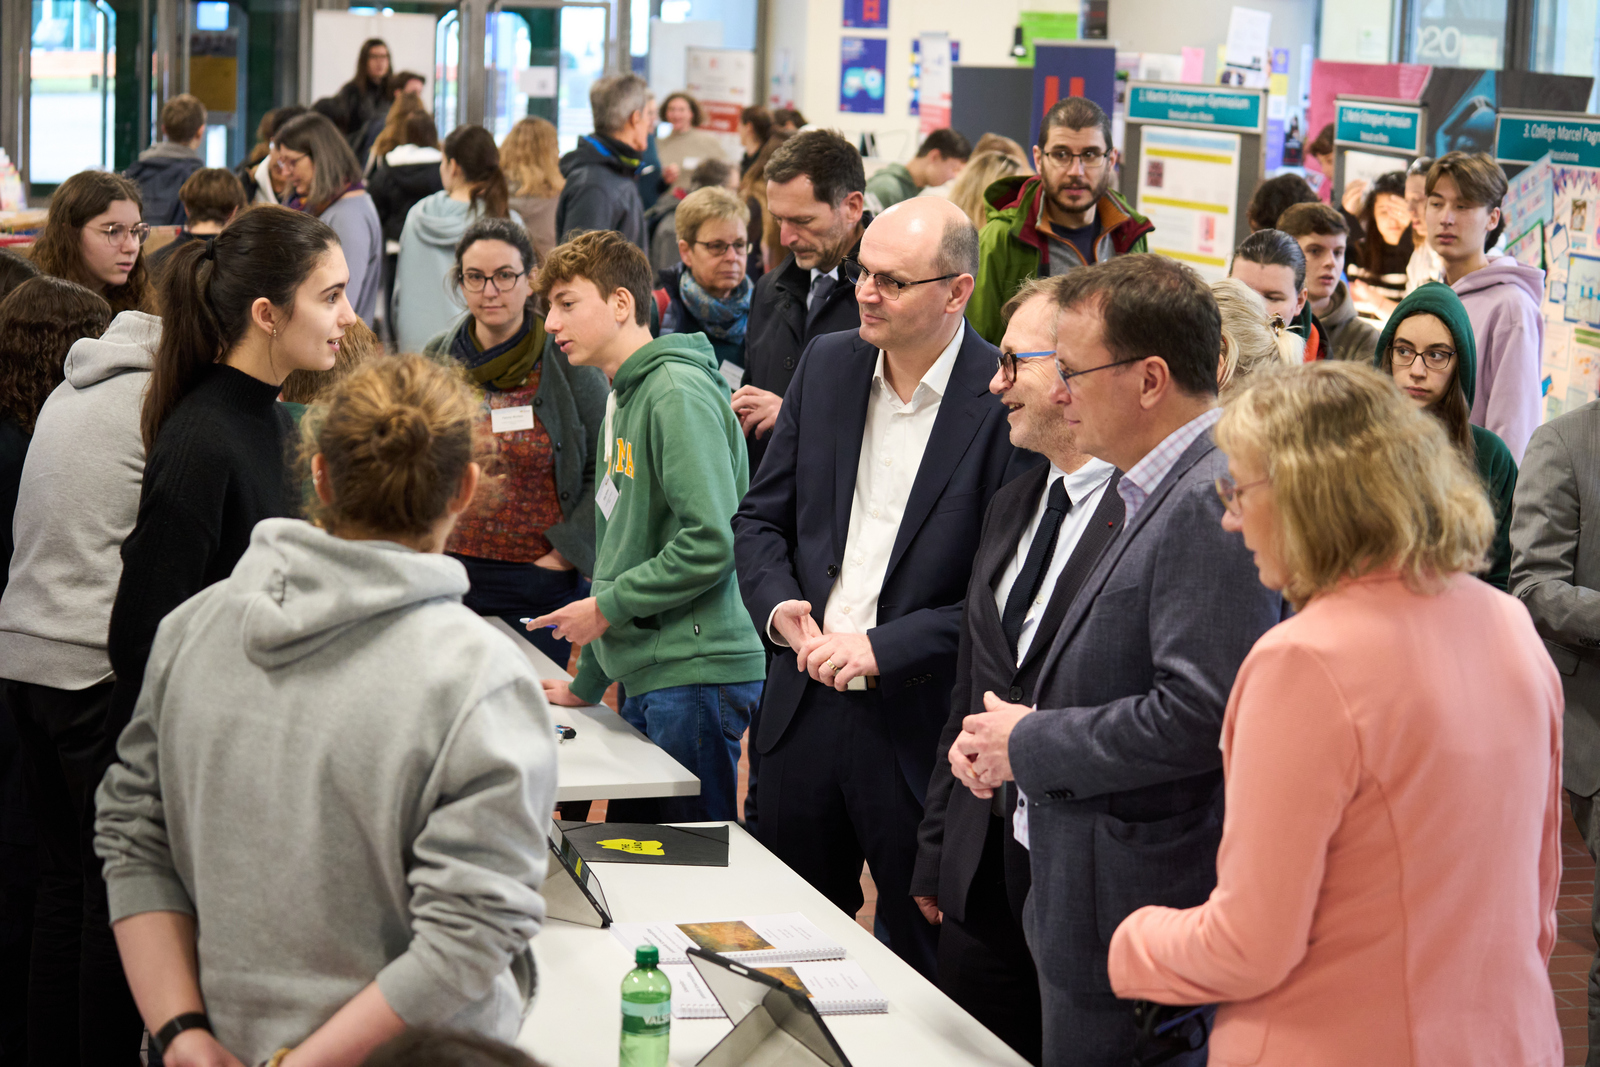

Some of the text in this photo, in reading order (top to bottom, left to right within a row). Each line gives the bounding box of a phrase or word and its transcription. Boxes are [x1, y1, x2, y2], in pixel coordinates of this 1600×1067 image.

[1523, 123, 1530, 138] 3.
[1531, 123, 1556, 142] Collège
[1557, 125, 1583, 142] Marcel
